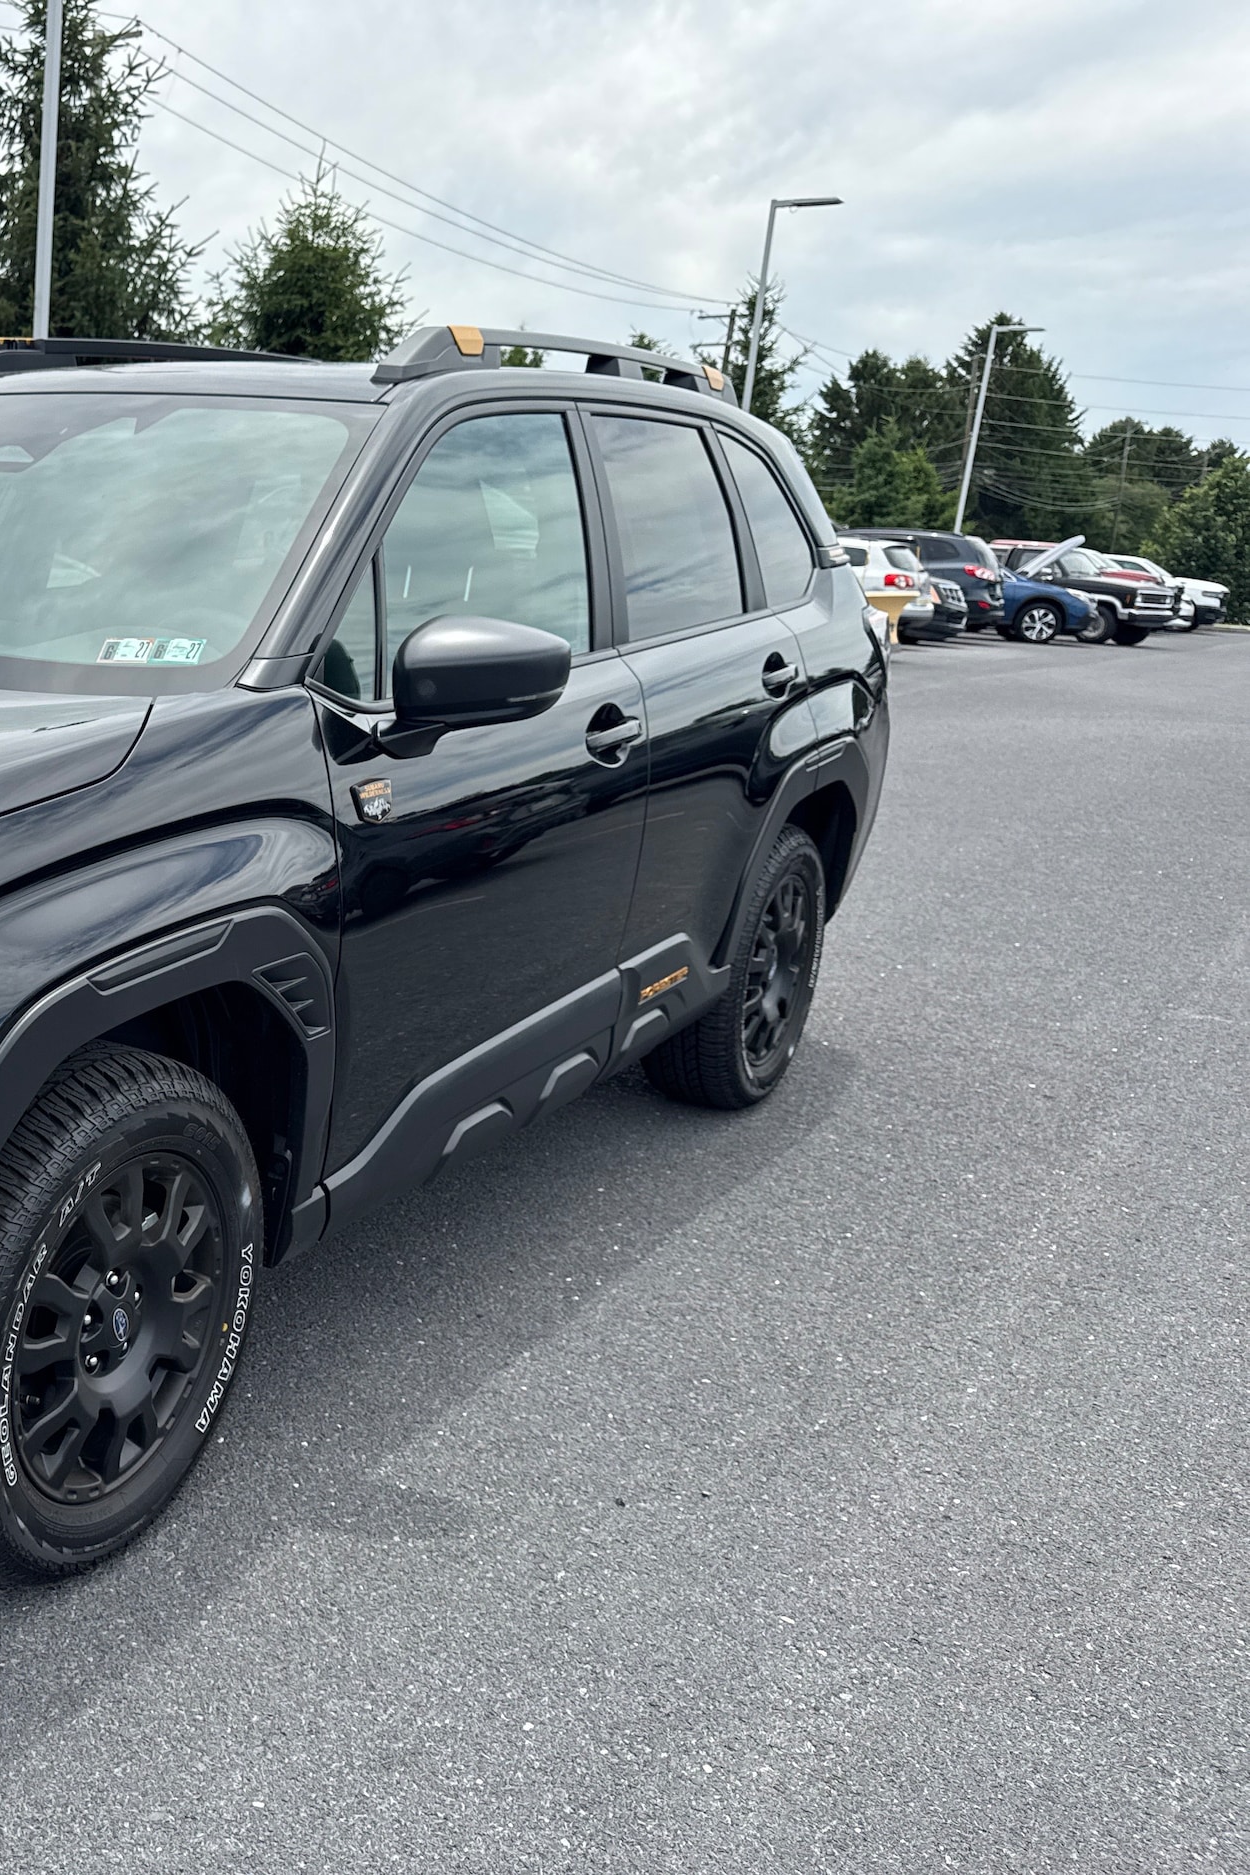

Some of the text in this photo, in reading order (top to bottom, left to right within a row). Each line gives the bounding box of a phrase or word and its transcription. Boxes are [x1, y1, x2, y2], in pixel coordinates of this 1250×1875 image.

[104, 641, 150, 660] 6 27
[154, 642, 201, 659] 6 27
[0, 1161, 102, 1487] GEOLANDAR A/T
[194, 1243, 254, 1434] YOKOHAMA
